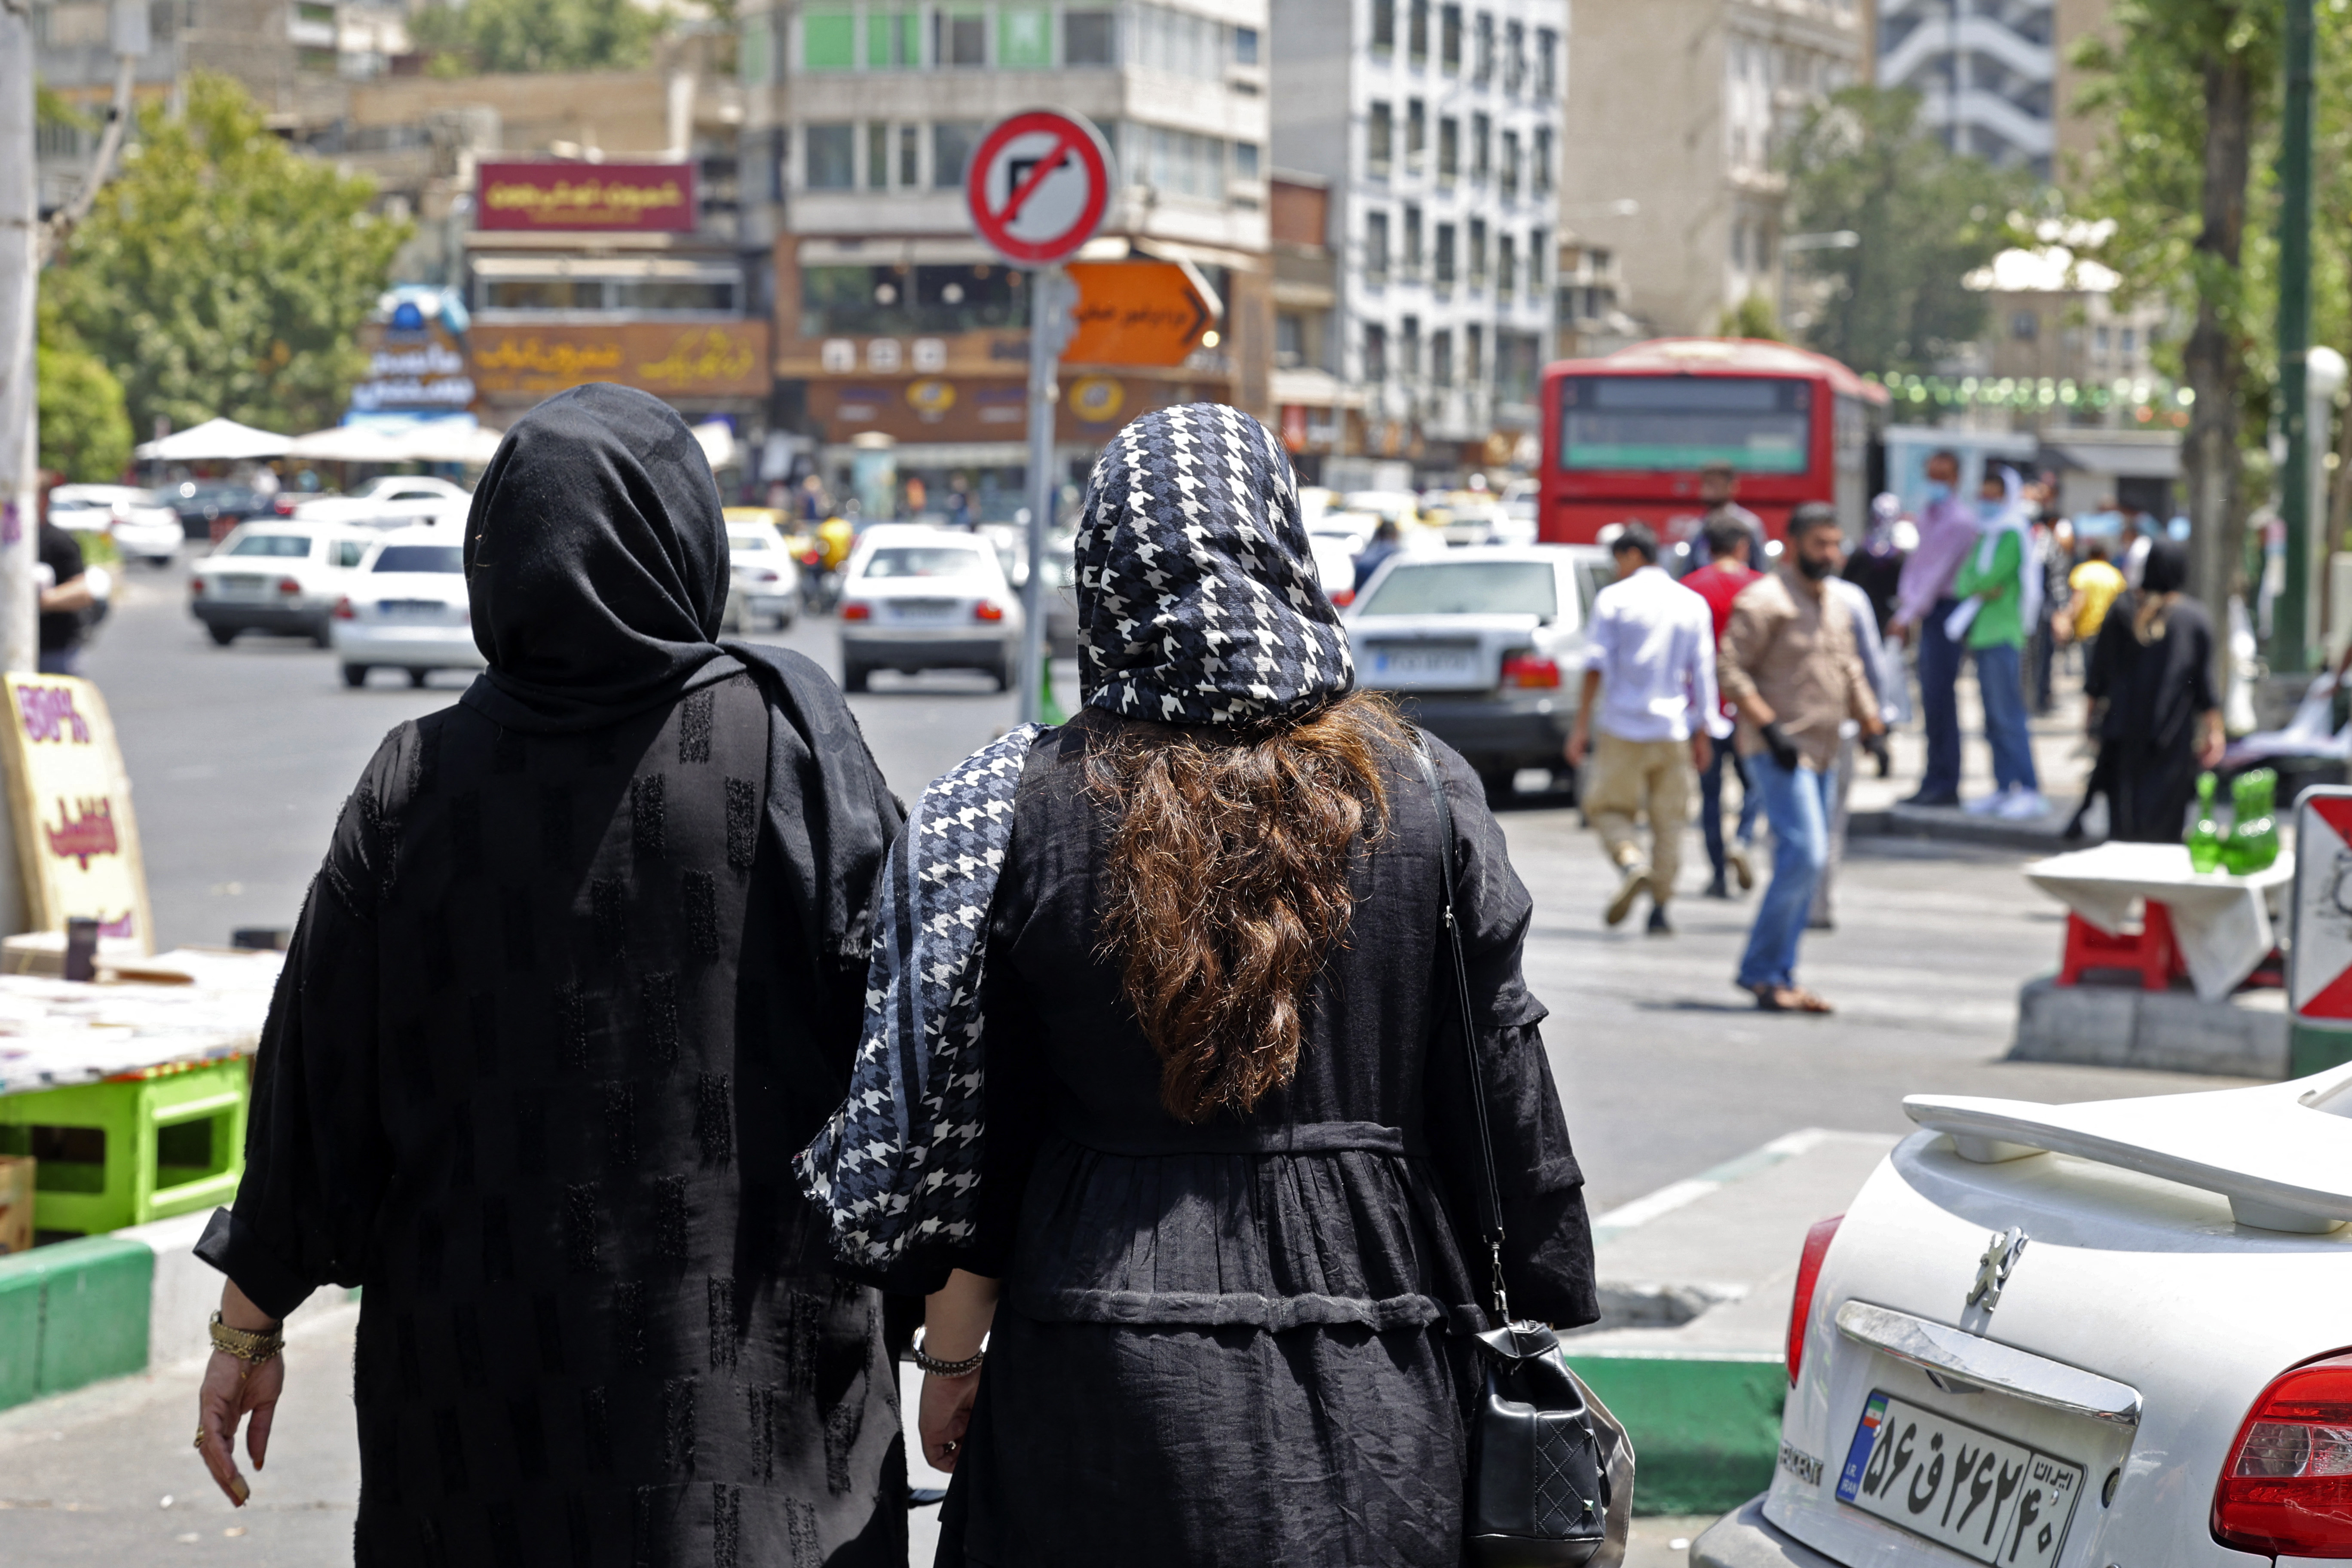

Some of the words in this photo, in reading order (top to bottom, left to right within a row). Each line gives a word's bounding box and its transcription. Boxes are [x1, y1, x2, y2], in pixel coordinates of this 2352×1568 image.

[1846, 1463, 1857, 1477] I.R.
[1862, 1416, 1917, 1499] ۵۶
[1908, 1432, 1945, 1514] ق
[1941, 1442, 2024, 1545] ۲۶۲
[2034, 1461, 2073, 1491] ایران
[1841, 1478, 1859, 1494] IRAN
[2009, 1488, 2052, 1562] ۴۰
